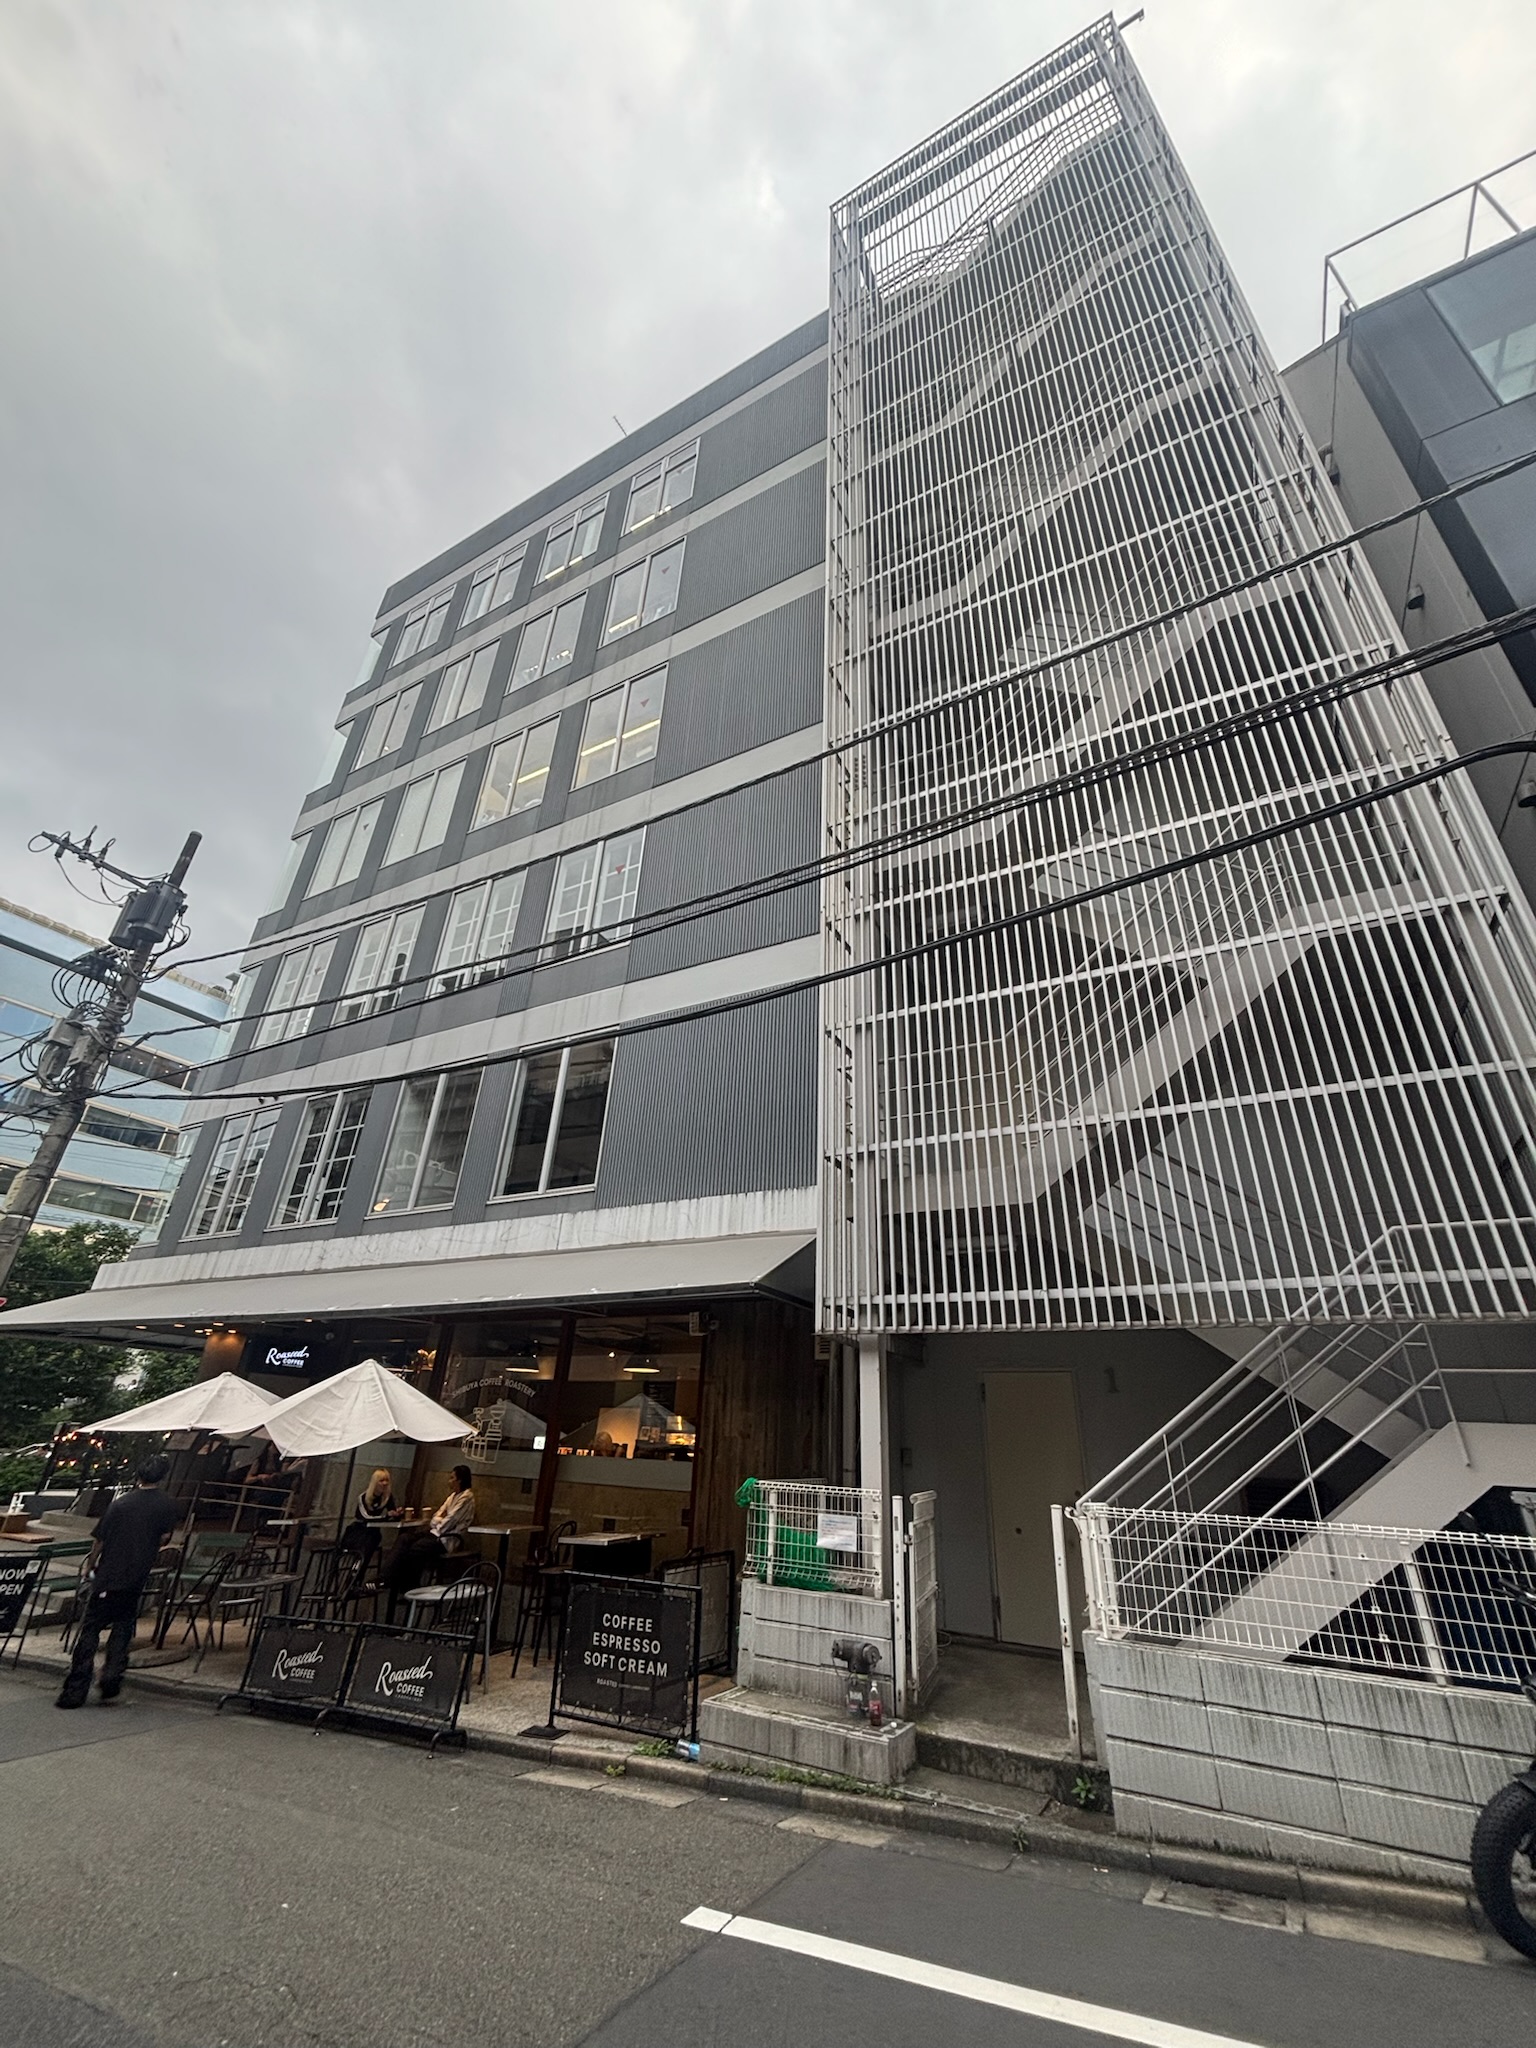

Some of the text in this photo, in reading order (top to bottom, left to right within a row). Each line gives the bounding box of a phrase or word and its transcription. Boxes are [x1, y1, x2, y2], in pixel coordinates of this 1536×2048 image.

[479, 1378, 502, 1387] COFFEE
[504, 1379, 536, 1397] ROASTERY
[602, 1613, 653, 1632] COFFEE
[593, 1632, 661, 1654] ESPRESSO
[271, 1641, 324, 1680] Roasted
[583, 1651, 668, 1677] SOFT CREAM
[290, 1667, 316, 1679] COFFEE
[375, 1655, 434, 1696] Roasted
[396, 1682, 425, 1697] COFFEE
[596, 1678, 618, 1688] ROASTED
